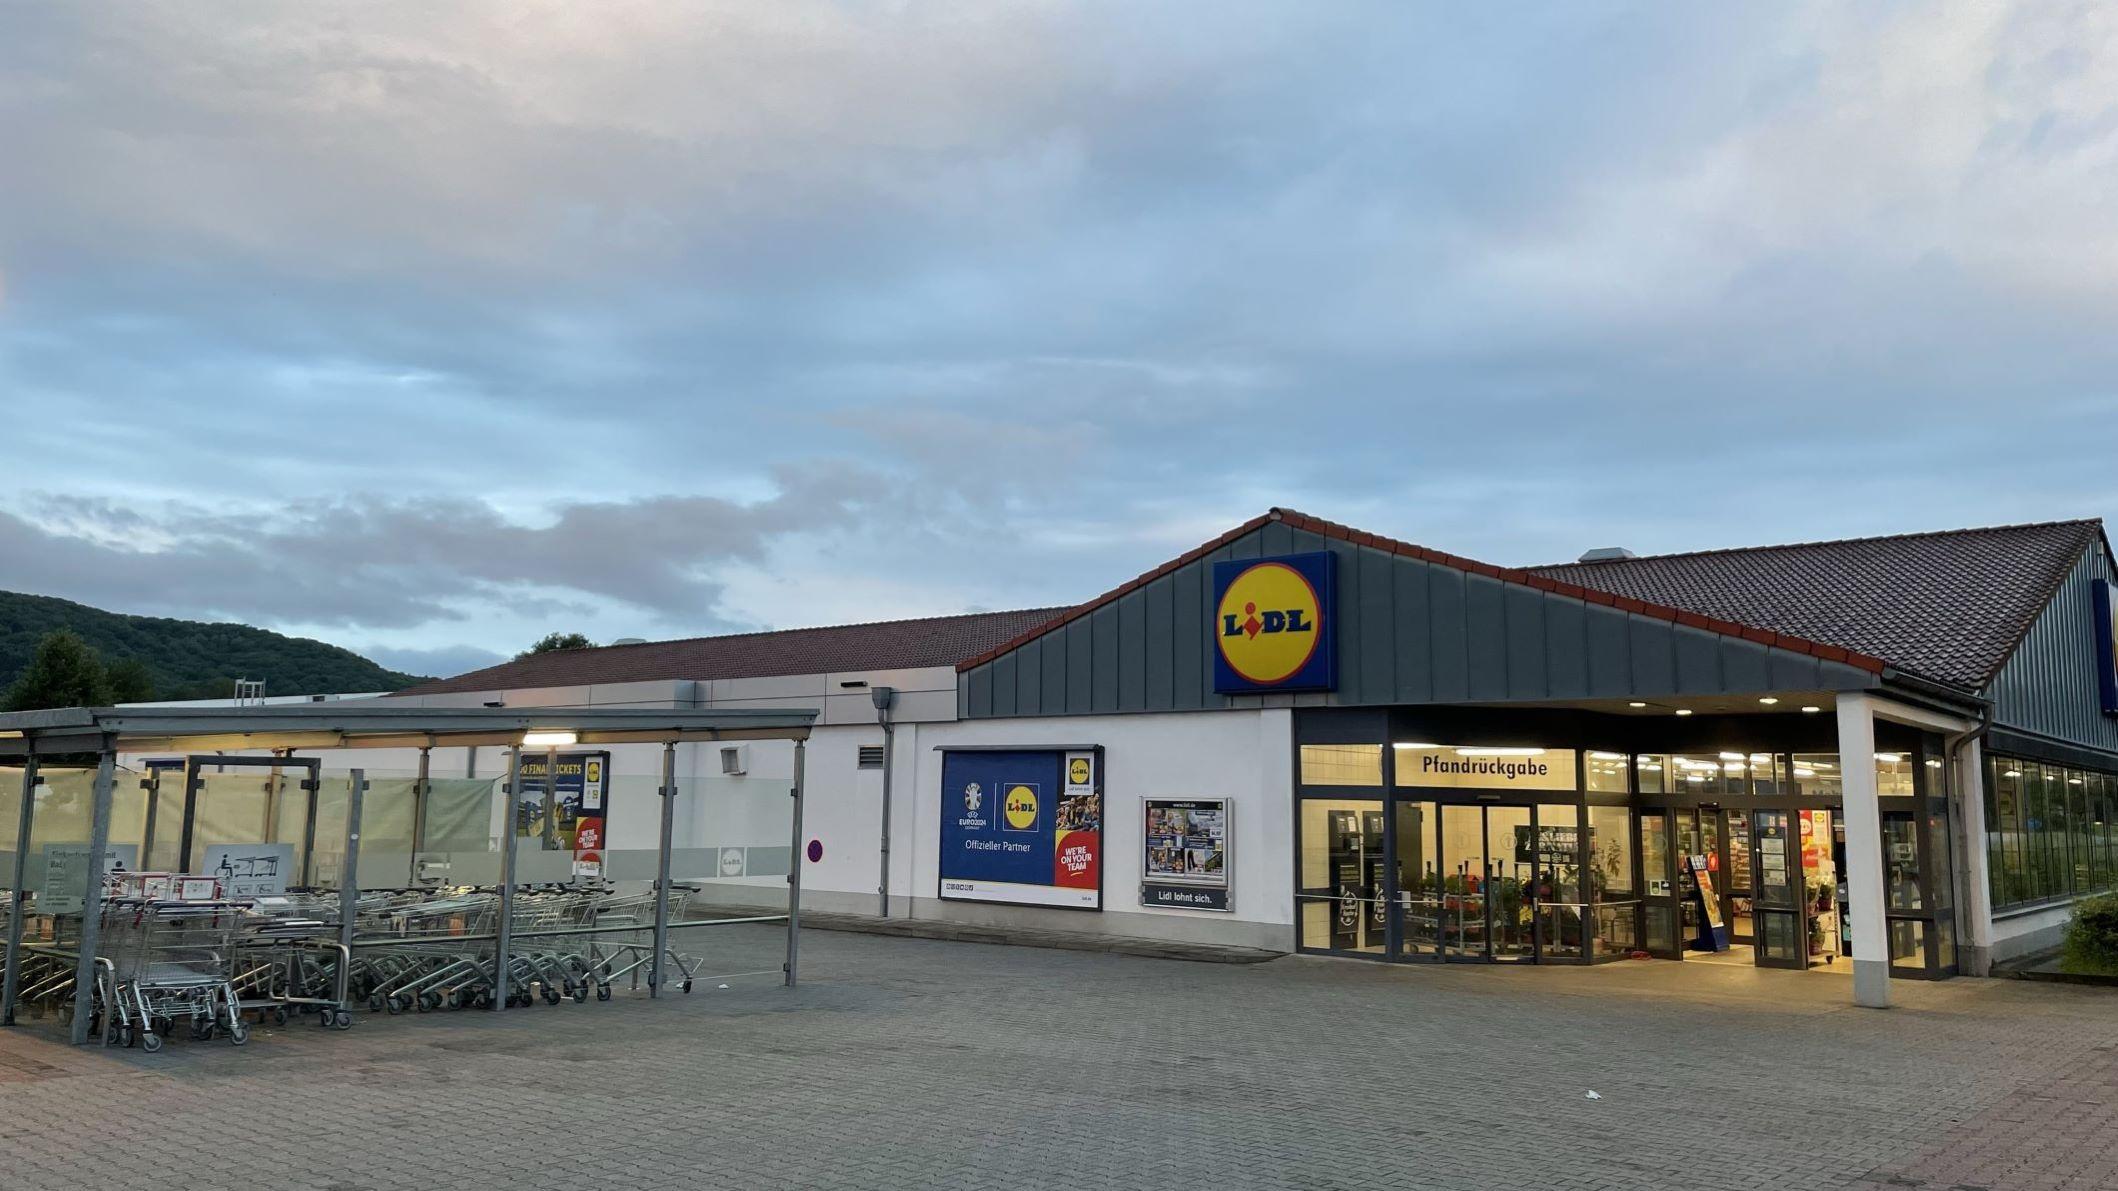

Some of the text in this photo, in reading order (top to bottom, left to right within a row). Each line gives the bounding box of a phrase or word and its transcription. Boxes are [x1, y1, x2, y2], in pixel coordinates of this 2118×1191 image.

[555, 764, 582, 775] ICKETS
[1423, 755, 1548, 779] Pfandrückgabe
[965, 839, 1031, 852] Offizieller Partner
[1065, 845, 1087, 856] WE'RE
[1060, 853, 1092, 864] ON YOUR
[1067, 861, 1087, 872] TEAM
[1158, 891, 1213, 904] Lidl lohnt sich.
